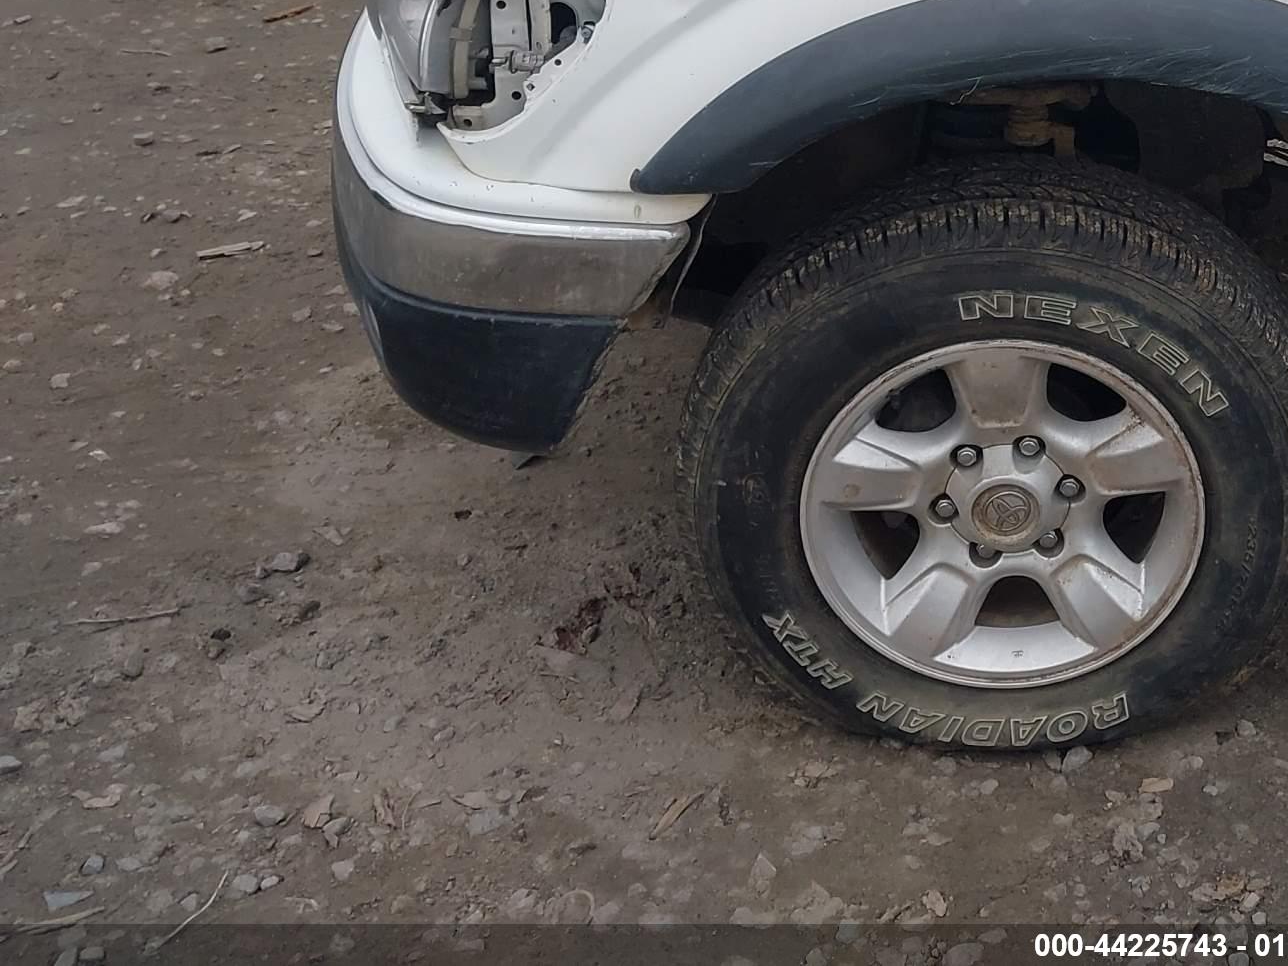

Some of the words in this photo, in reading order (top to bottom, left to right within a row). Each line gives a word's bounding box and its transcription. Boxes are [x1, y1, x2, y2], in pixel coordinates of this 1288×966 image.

[957, 290, 1230, 418] NEXEN
[760, 610, 855, 691] HTX
[855, 690, 1131, 747] ROADIAN
